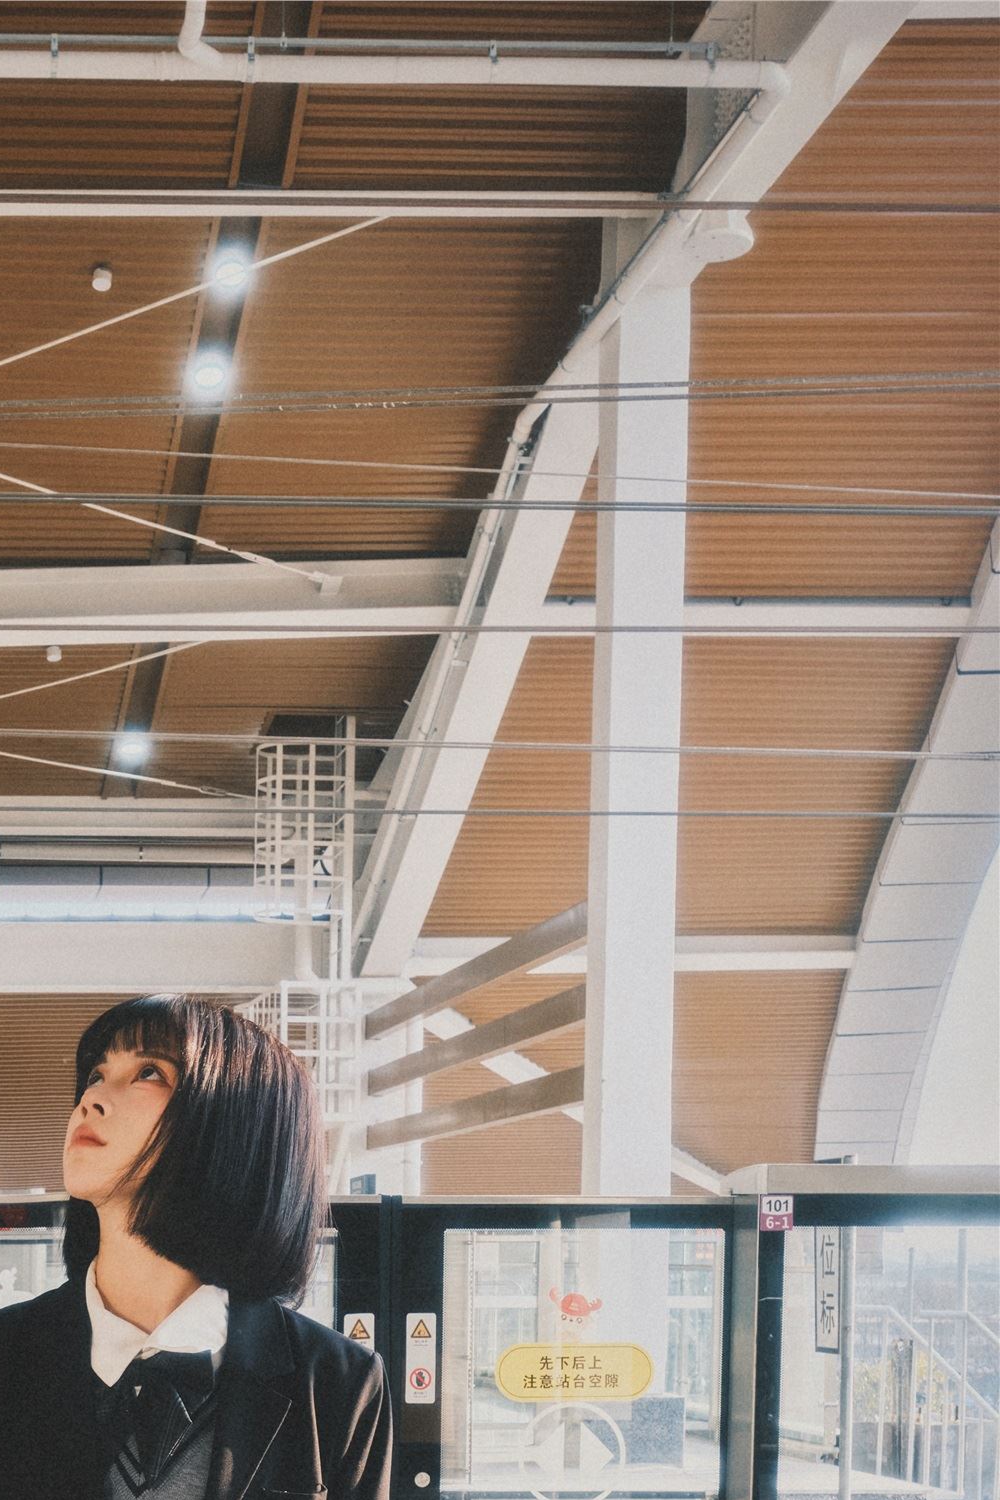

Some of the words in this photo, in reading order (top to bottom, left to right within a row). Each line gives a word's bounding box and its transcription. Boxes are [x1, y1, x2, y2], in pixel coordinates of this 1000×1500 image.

[766, 1200, 789, 1212] 101
[766, 1216, 789, 1229] 6-1
[540, 1356, 602, 1370] 先下后上
[523, 1374, 619, 1389] 注意站台空隙
